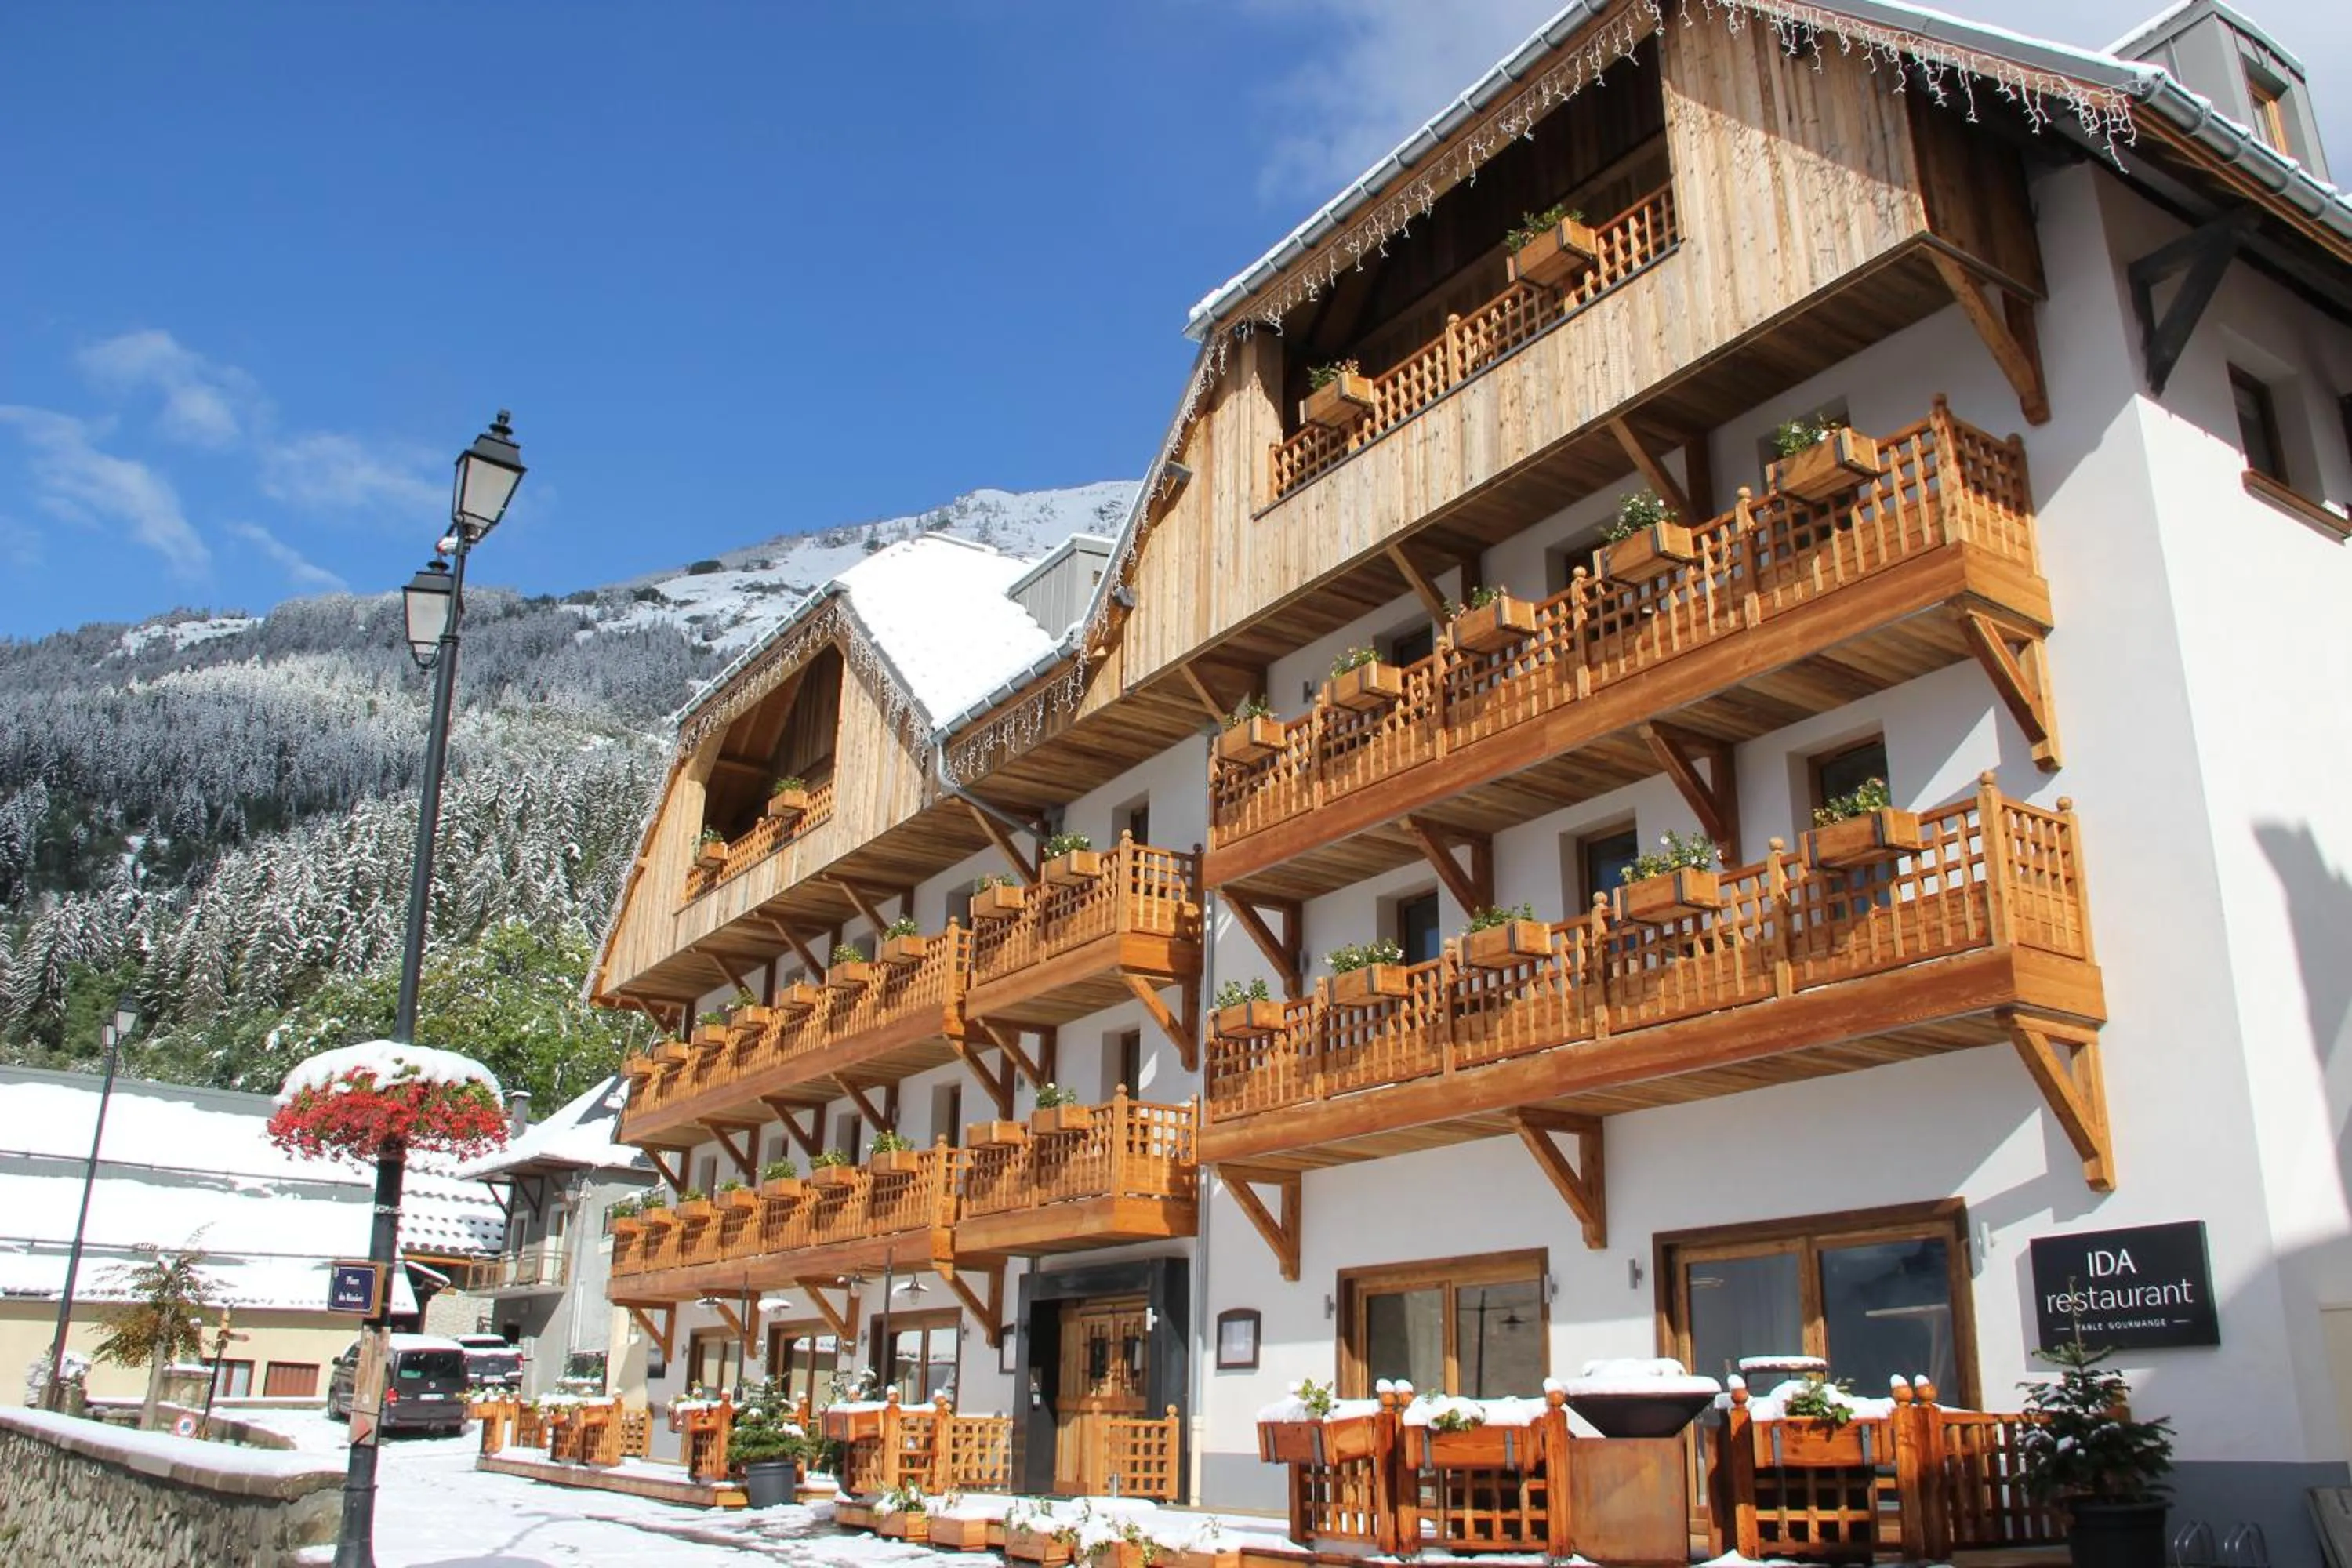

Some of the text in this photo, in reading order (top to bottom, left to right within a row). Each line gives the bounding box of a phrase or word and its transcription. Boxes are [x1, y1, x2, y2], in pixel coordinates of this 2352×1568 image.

[2087, 1249, 2137, 1277] IDA
[2047, 1279, 2194, 1313] restaurant
[2108, 1318, 2167, 1330] GOURMANDE
